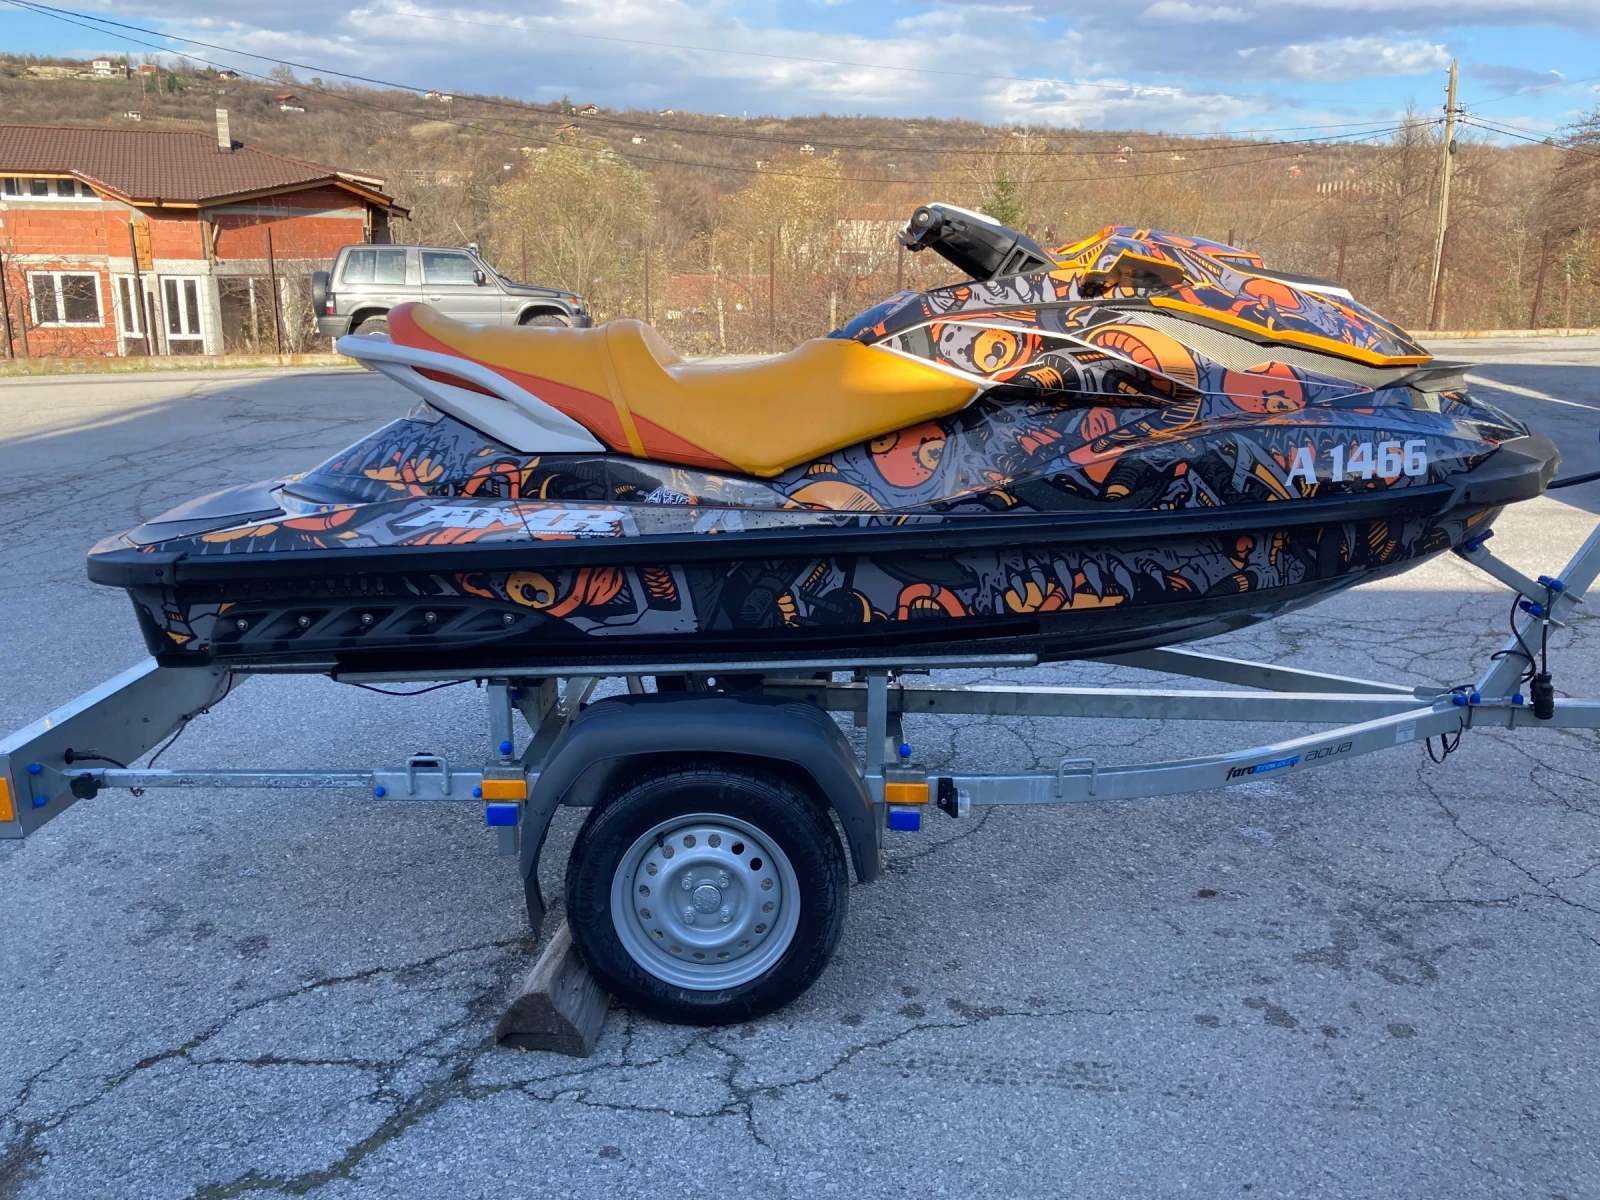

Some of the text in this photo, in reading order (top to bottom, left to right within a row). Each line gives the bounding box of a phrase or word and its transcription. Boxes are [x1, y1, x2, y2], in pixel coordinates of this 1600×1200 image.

[1284, 439, 1427, 487] A 1466
[1304, 741, 1353, 762] aqua
